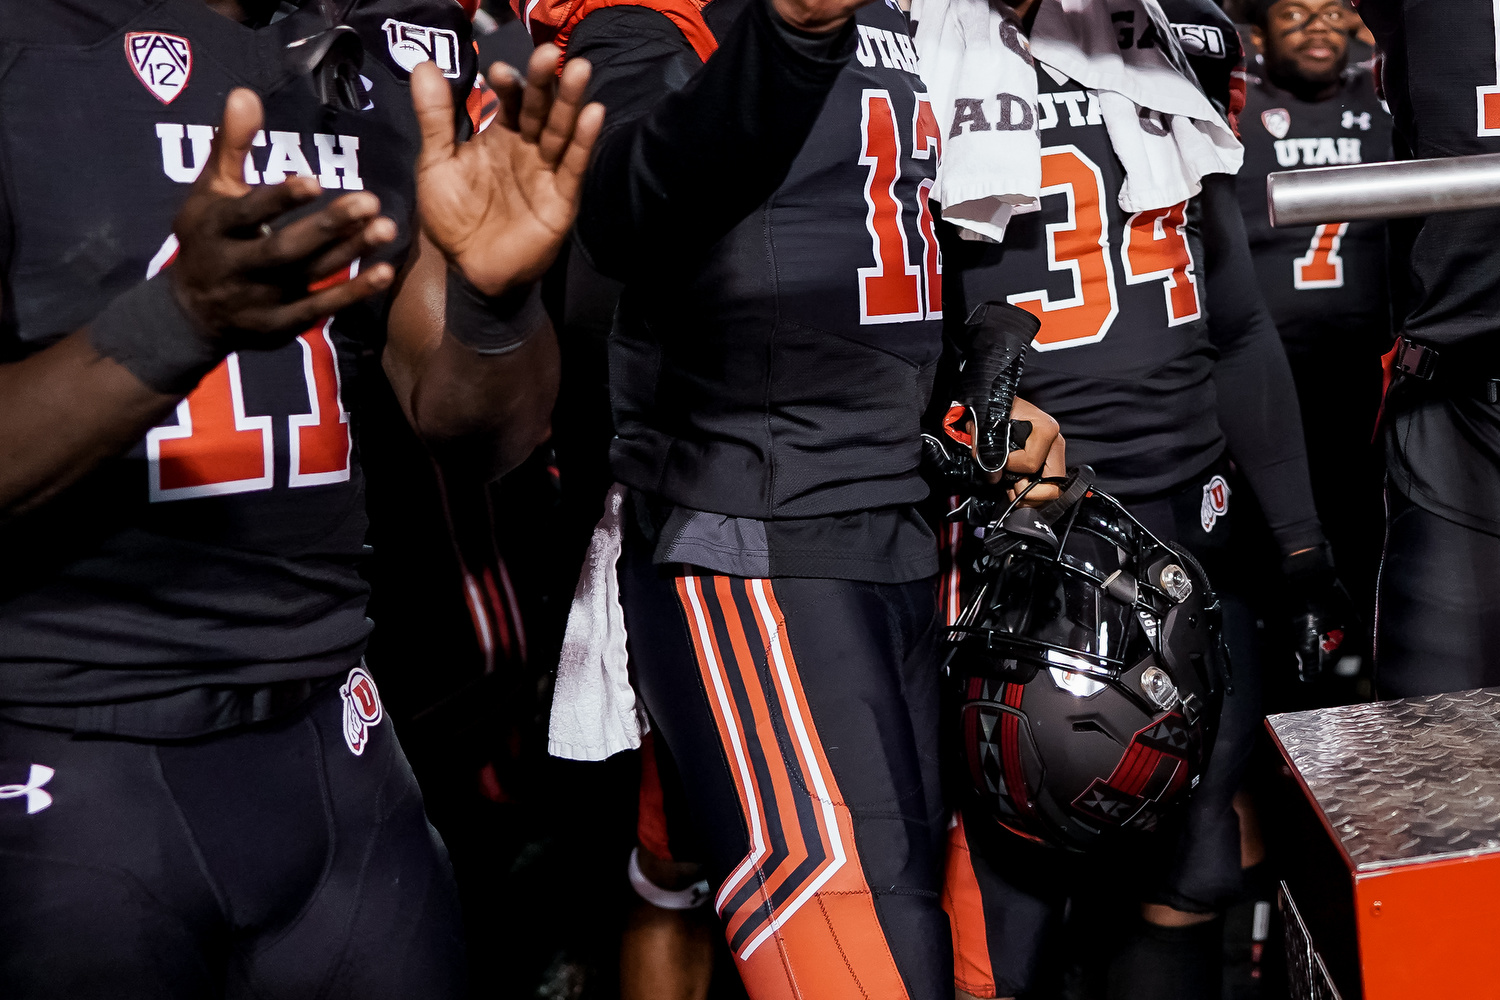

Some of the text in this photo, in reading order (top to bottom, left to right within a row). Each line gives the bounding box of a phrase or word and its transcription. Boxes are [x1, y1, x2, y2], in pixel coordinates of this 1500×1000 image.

[131, 35, 187, 75] PAC
[148, 63, 179, 86] 12
[1274, 137, 1362, 167] UTAH
[1006, 144, 1201, 352] 34
[352, 678, 377, 717] U
